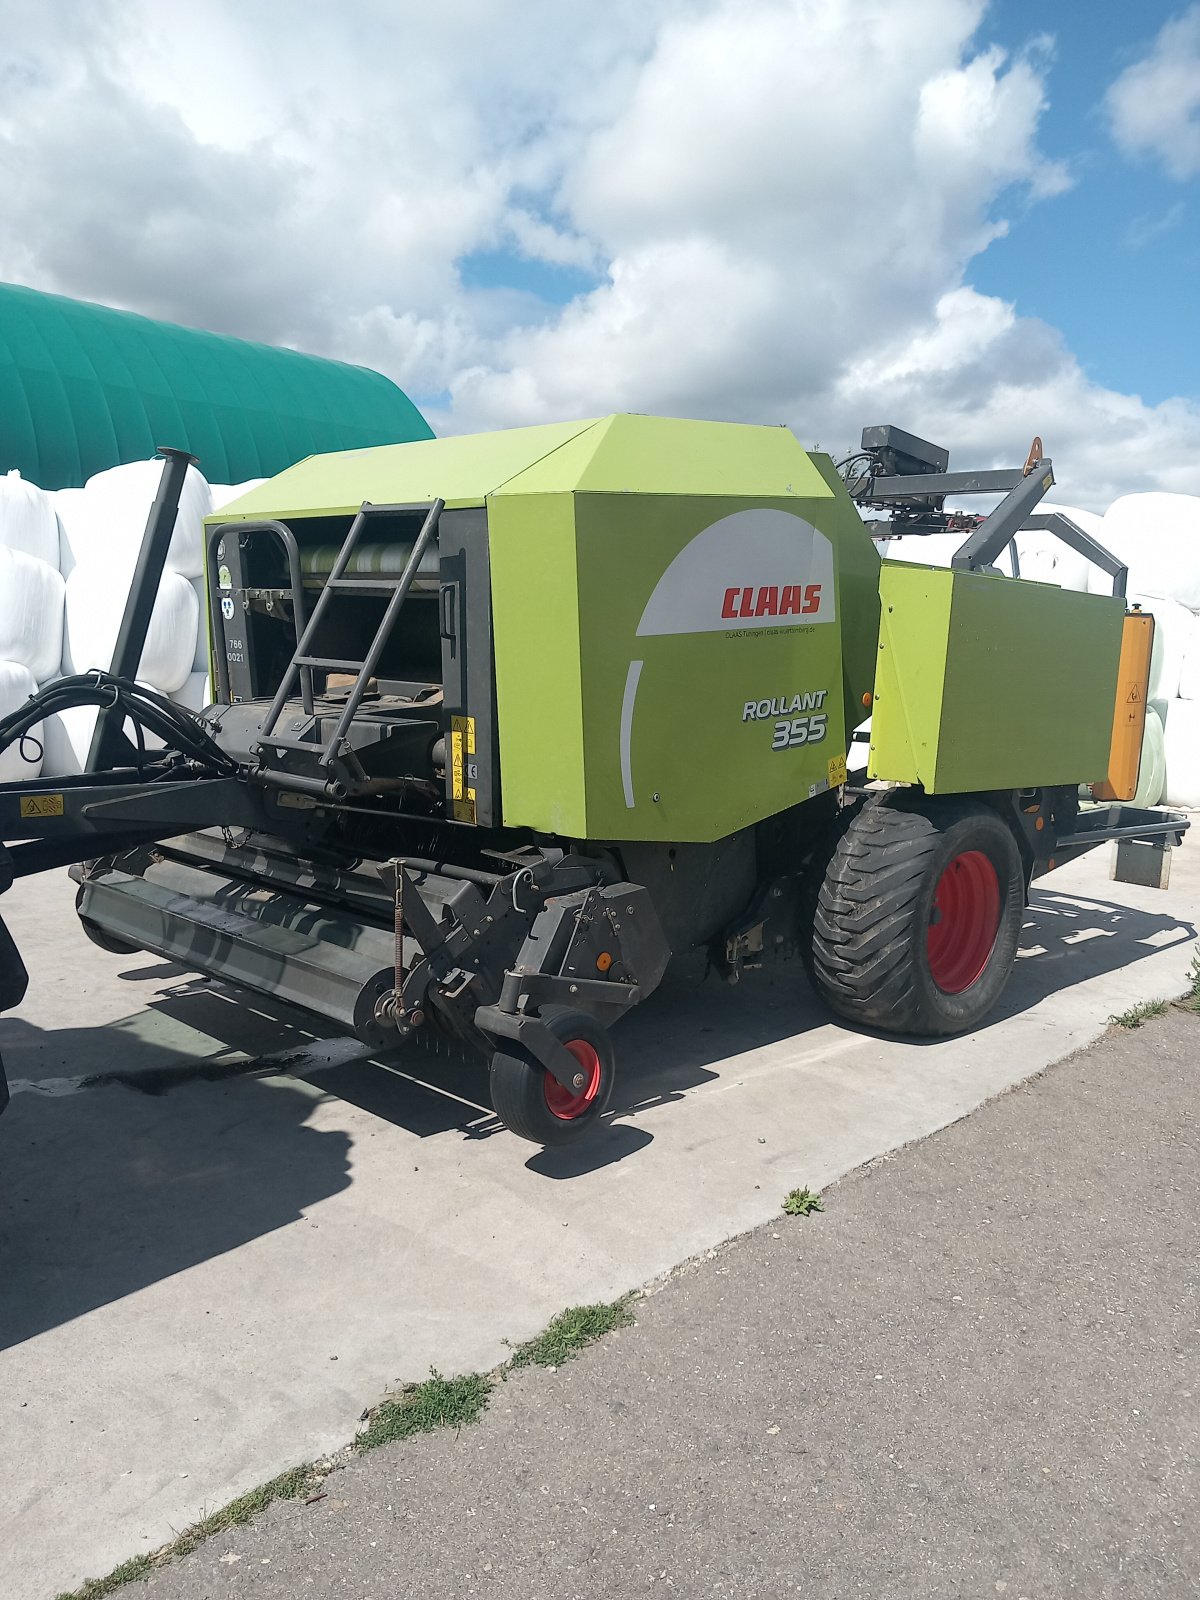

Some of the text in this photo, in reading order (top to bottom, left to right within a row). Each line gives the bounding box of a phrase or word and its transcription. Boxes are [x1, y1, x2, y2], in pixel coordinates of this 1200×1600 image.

[721, 584, 821, 619] CLAAS
[227, 652, 244, 663] 0021
[229, 639, 243, 650] 766
[742, 690, 828, 722] ROLLANT
[771, 714, 828, 751] 355
